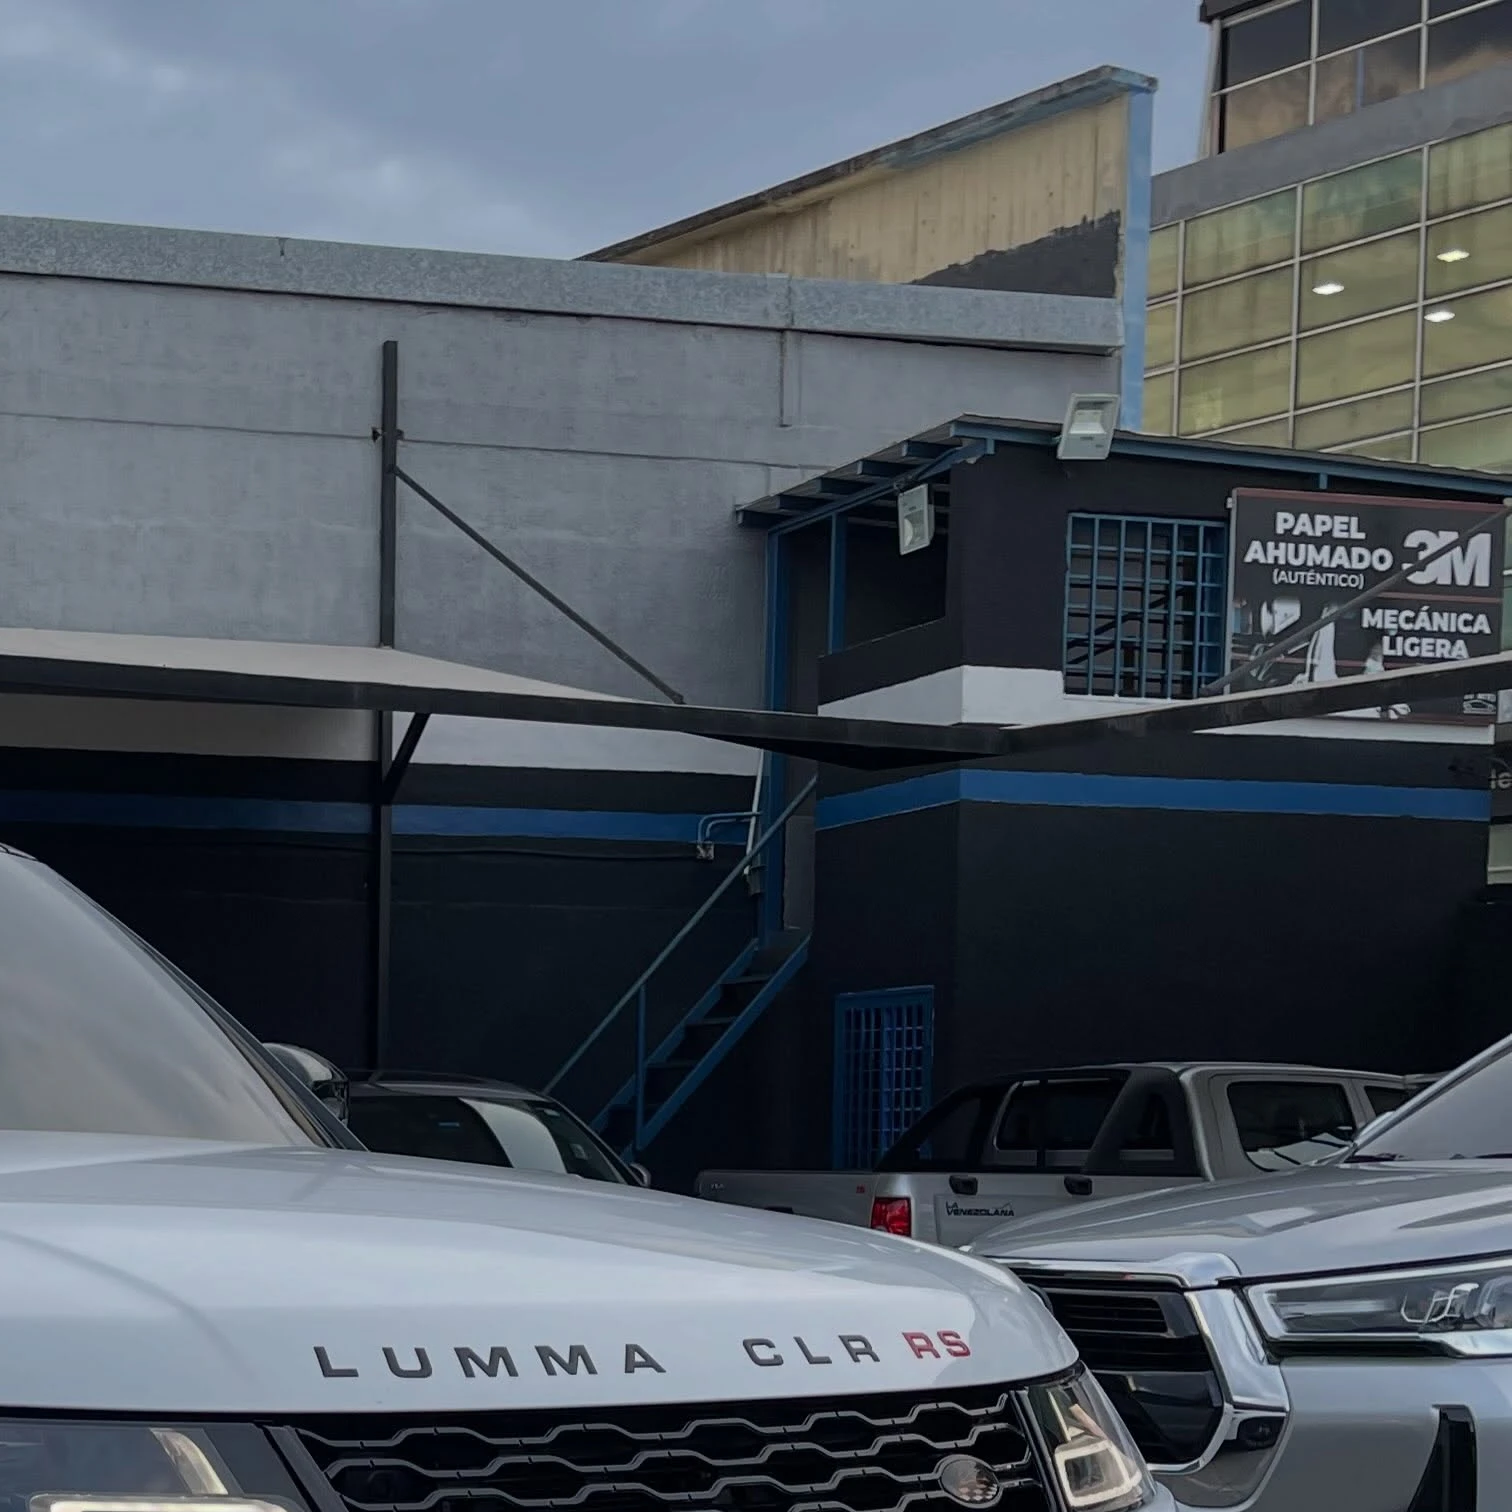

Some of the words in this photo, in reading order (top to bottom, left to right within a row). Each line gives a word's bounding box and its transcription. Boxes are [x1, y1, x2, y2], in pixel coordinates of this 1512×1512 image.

[1275, 511, 1366, 540] PAPEL
[1243, 540, 1394, 572] AHUMADO
[1401, 529, 1492, 588] 3M
[1272, 569, 1365, 590] (AUTÉNTICO)
[1361, 605, 1492, 634] MECÁNICA
[1381, 635, 1471, 660] LIGERA
[313, 1342, 667, 1379] LUMMA
[741, 1334, 881, 1366] CLR
[901, 1329, 972, 1360] RS
